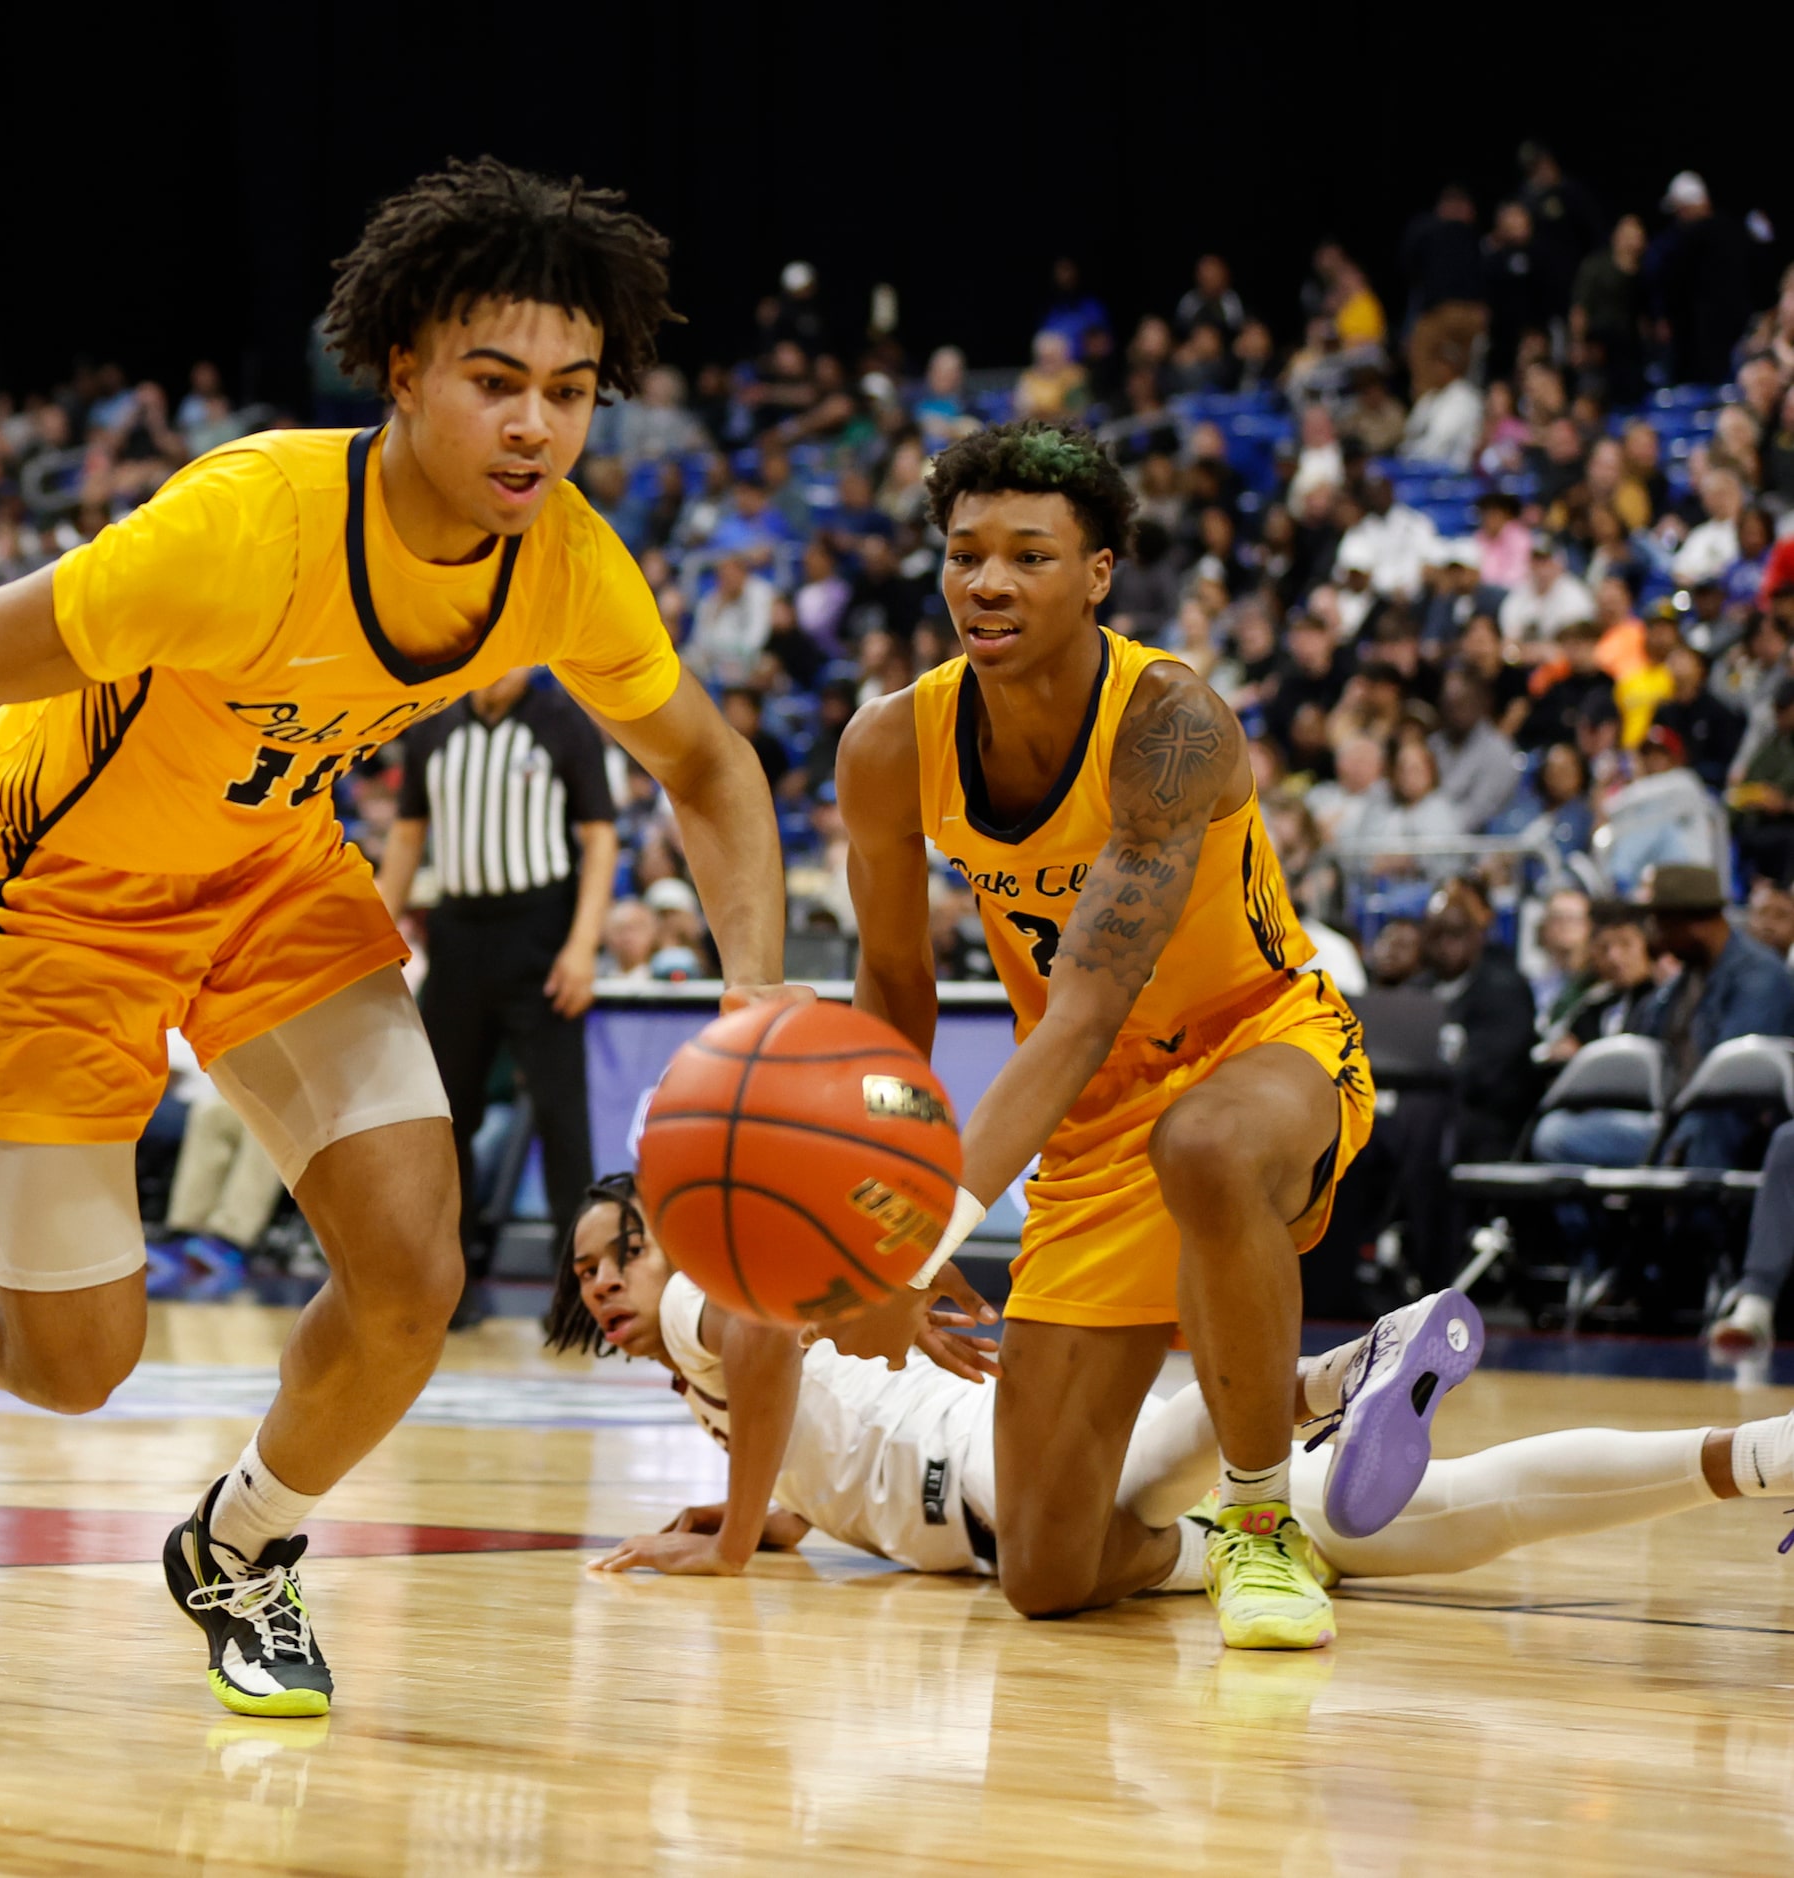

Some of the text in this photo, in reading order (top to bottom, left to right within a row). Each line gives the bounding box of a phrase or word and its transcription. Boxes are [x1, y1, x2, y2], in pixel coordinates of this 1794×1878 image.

[1035, 862, 1093, 897] Cl
[1115, 848, 1177, 890] Glory
[1115, 881, 1144, 906] to
[1093, 907, 1146, 940] God
